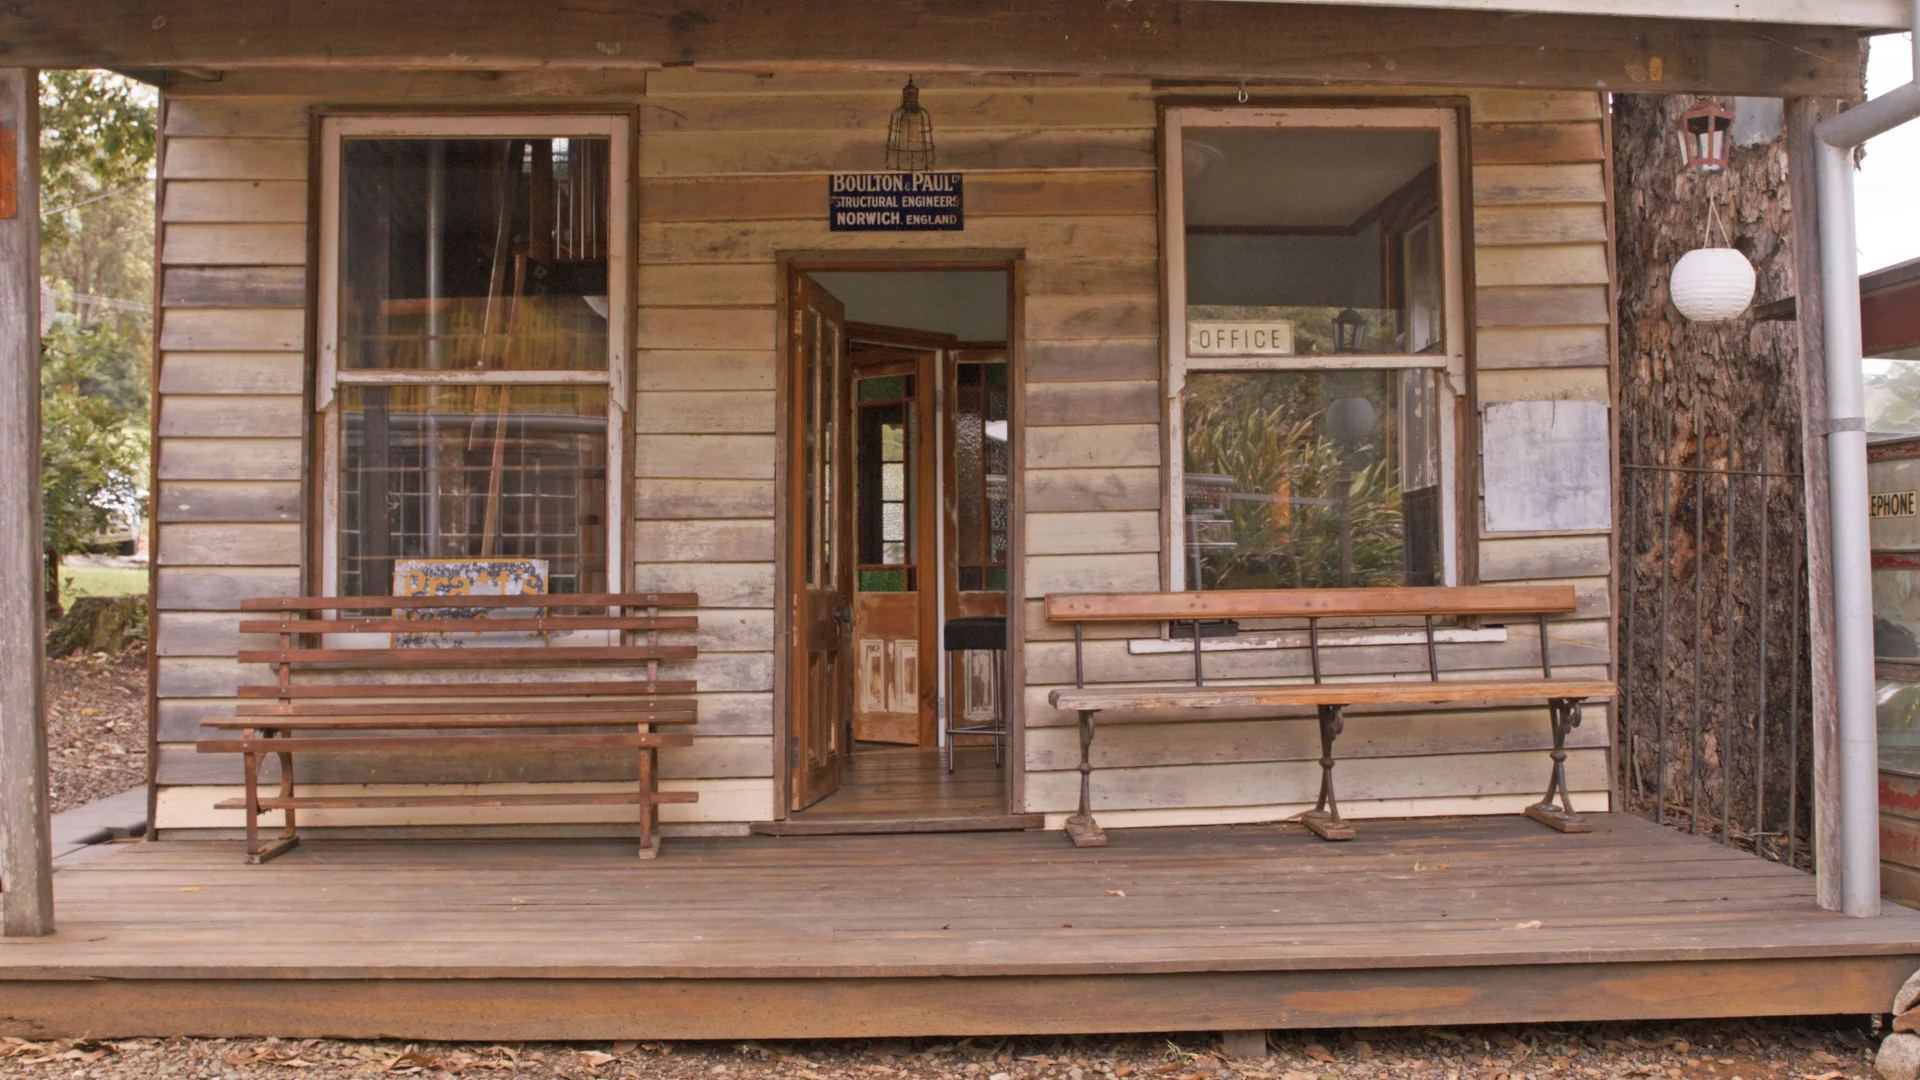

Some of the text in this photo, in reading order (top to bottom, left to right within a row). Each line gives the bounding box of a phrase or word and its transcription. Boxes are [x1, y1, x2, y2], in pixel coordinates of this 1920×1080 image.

[833, 173, 903, 192] BOULTON
[904, 181, 911, 192] &
[912, 173, 953, 192] PAUL
[834, 195, 960, 208] STRUCTURAL ENGINEERS
[906, 214, 958, 225] ENGLAND
[1199, 329, 1281, 349] OFFICE
[1869, 492, 1914, 517] EPHONE
